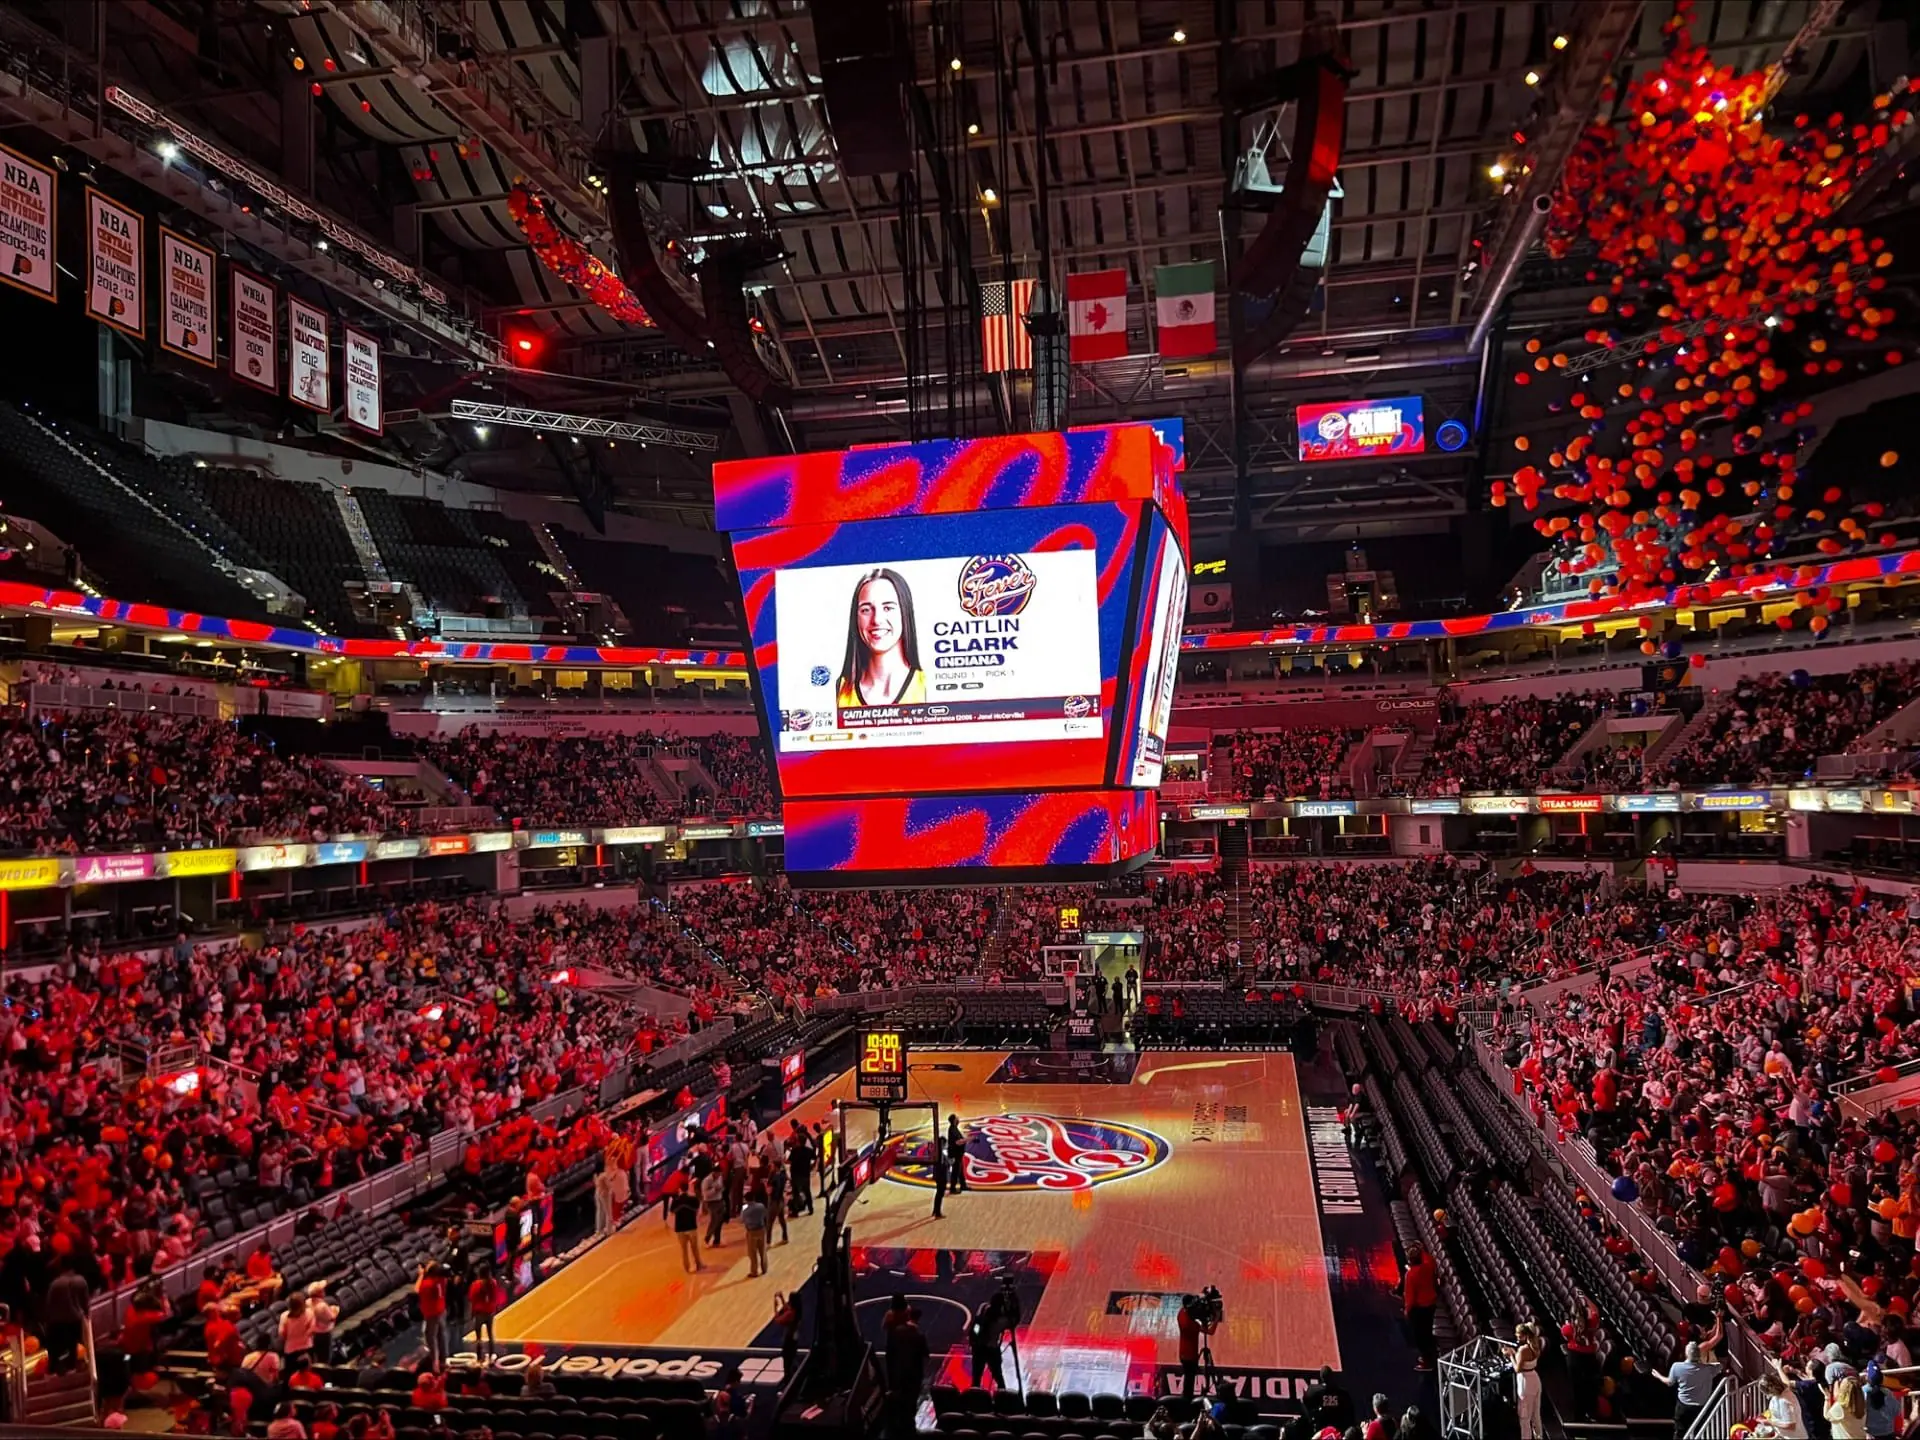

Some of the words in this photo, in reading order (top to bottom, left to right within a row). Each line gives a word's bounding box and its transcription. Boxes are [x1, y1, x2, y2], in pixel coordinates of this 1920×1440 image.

[4, 162, 40, 195] NBA
[0, 182, 45, 212] CENTRAL
[0, 194, 44, 225] DIVISION
[0, 210, 46, 245] CHAMPIONS
[100, 208, 131, 239] NBA
[0, 231, 46, 260] 2003-04
[97, 227, 133, 254] CENTRAL
[96, 255, 135, 286] CHAMPIONS
[173, 246, 204, 275] NBA
[172, 266, 205, 290] CENTRAL
[242, 282, 267, 305] WNBA
[170, 291, 207, 320] CHAMPIONS
[240, 301, 267, 321] EASTERN
[237, 310, 272, 334] CONFERENCE
[296, 309, 321, 334] WNBA
[238, 322, 271, 344] CHAMPIONS
[295, 328, 325, 352] CHAMPIONS
[246, 340, 264, 357] 2009
[352, 339, 372, 357] WNBA
[301, 351, 318, 368] 2012
[349, 374, 376, 391] CHAMPIONS
[1358, 435, 1393, 446] PARTY
[968, 554, 1022, 574] INDIANA
[963, 567, 1036, 610] Fever
[934, 618, 1020, 636] CAITLIN
[934, 636, 1019, 653] CLARK
[940, 655, 1000, 667] INDIANA
[936, 672, 967, 680] ROUND
[843, 710, 871, 719] CAITLIN
[872, 708, 900, 718] CLARK
[1392, 700, 1435, 708] LEXUS
[1300, 803, 1328, 816] ksm
[1473, 801, 1508, 812] KeyBank
[1542, 800, 1565, 808] STEAK
[1572, 800, 1599, 808] SHAKE
[106, 856, 144, 866] Ascension
[183, 853, 233, 868] GAINBRIDGE
[1061, 916, 1077, 928] 24
[1072, 1026, 1091, 1034] TIRE
[867, 1034, 899, 1048] 10:00
[866, 1049, 897, 1072] 24
[964, 1113, 1093, 1190] Fever
[1317, 1169, 1360, 1197] GROW
[1322, 1199, 1364, 1214] WE
[1167, 1372, 1318, 1400] NDIANA
